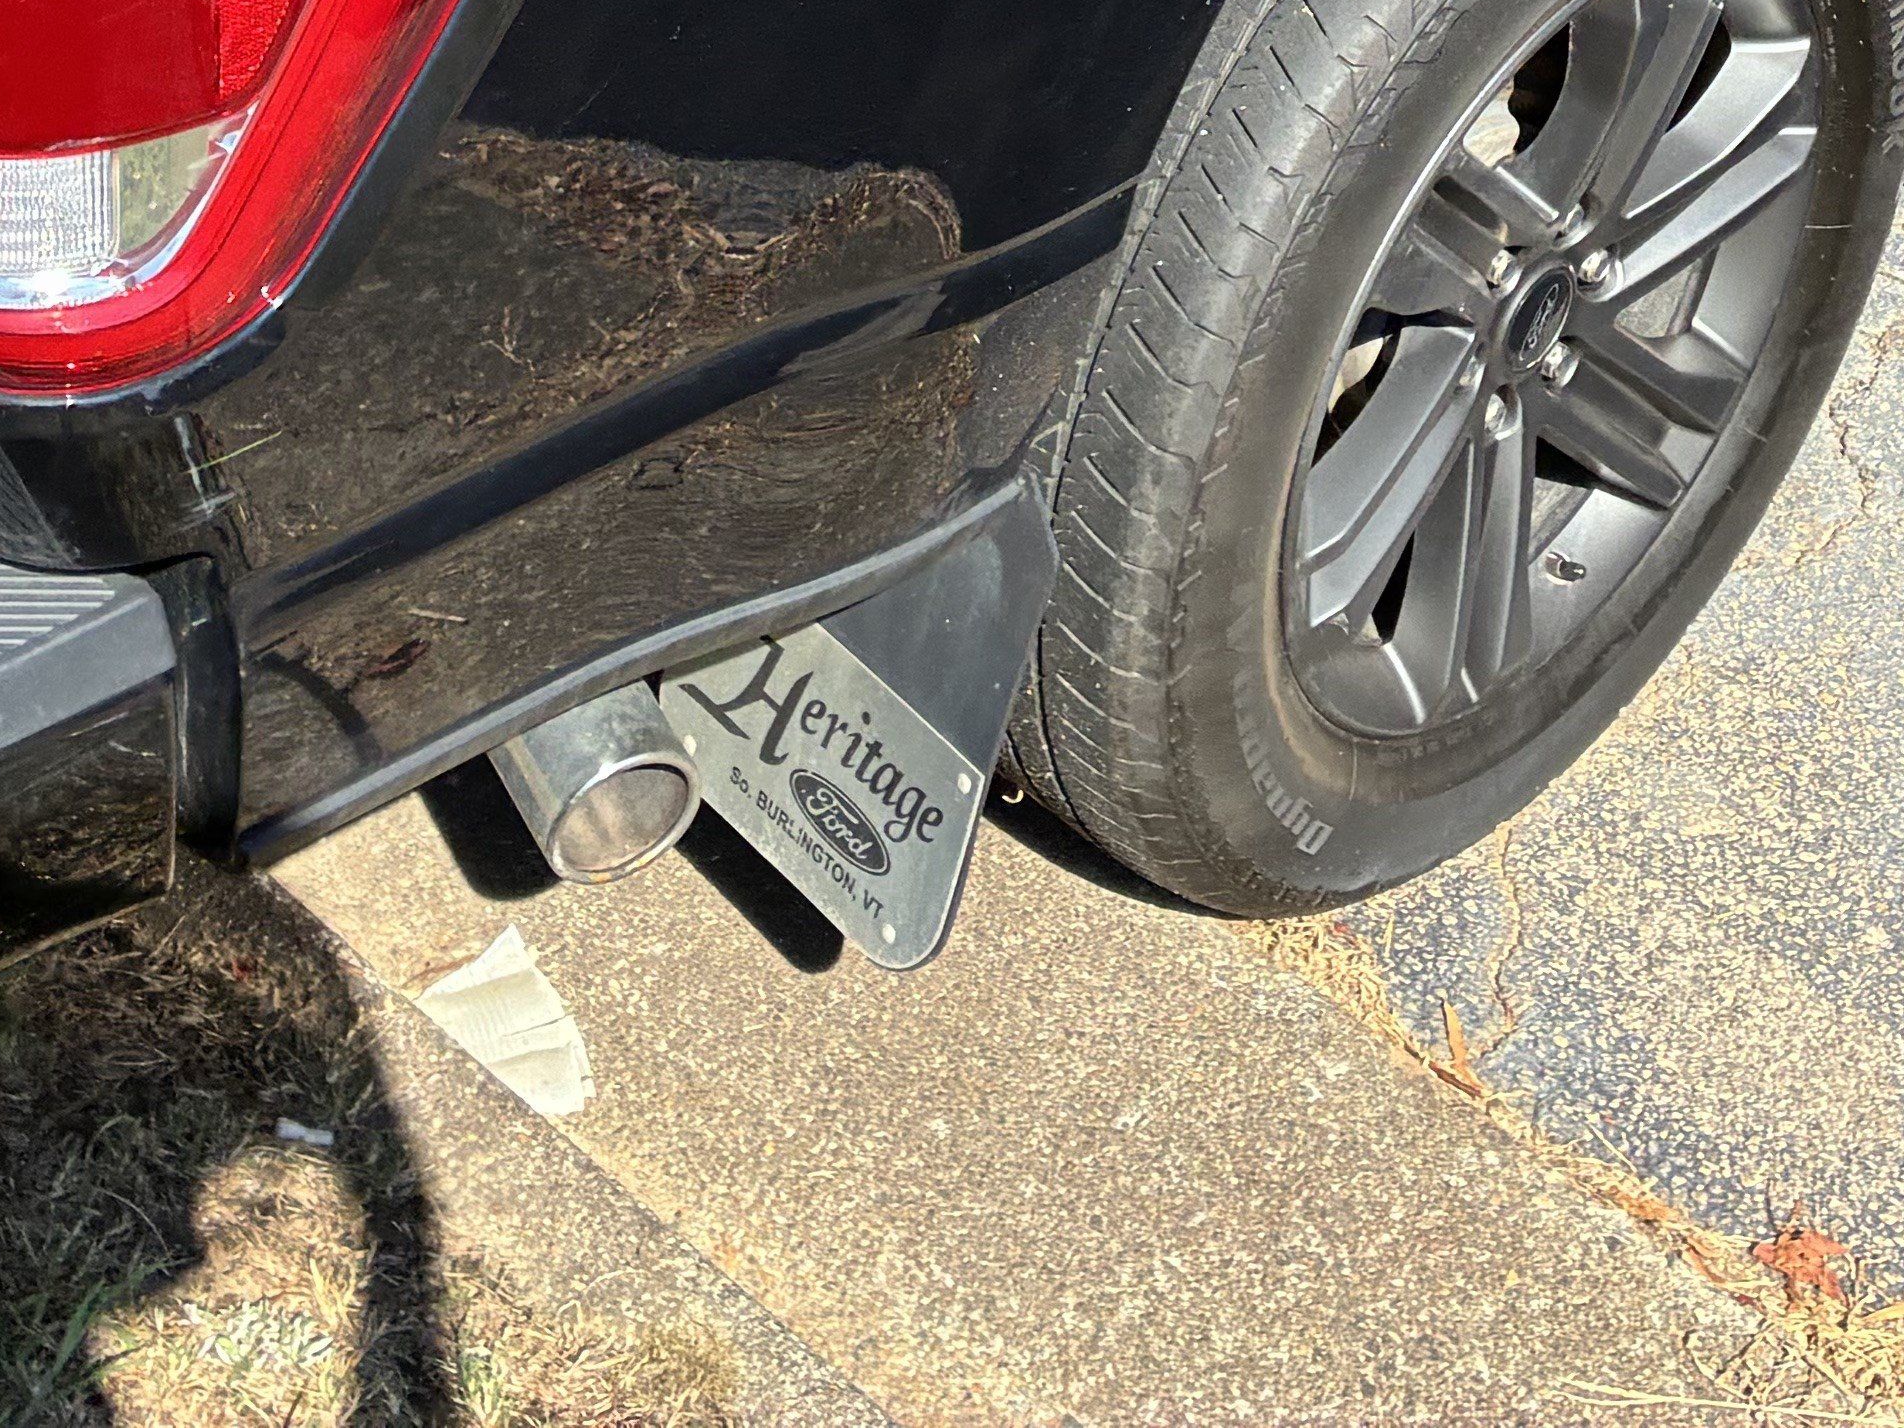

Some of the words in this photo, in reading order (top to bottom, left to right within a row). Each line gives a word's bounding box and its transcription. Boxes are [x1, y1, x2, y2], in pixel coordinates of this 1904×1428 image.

[1518, 283, 1559, 362] Ford
[679, 635, 945, 844] Heritage
[756, 793, 857, 903] BURLINGTON,
[863, 885, 886, 919] VT
[805, 786, 876, 861] Ford
